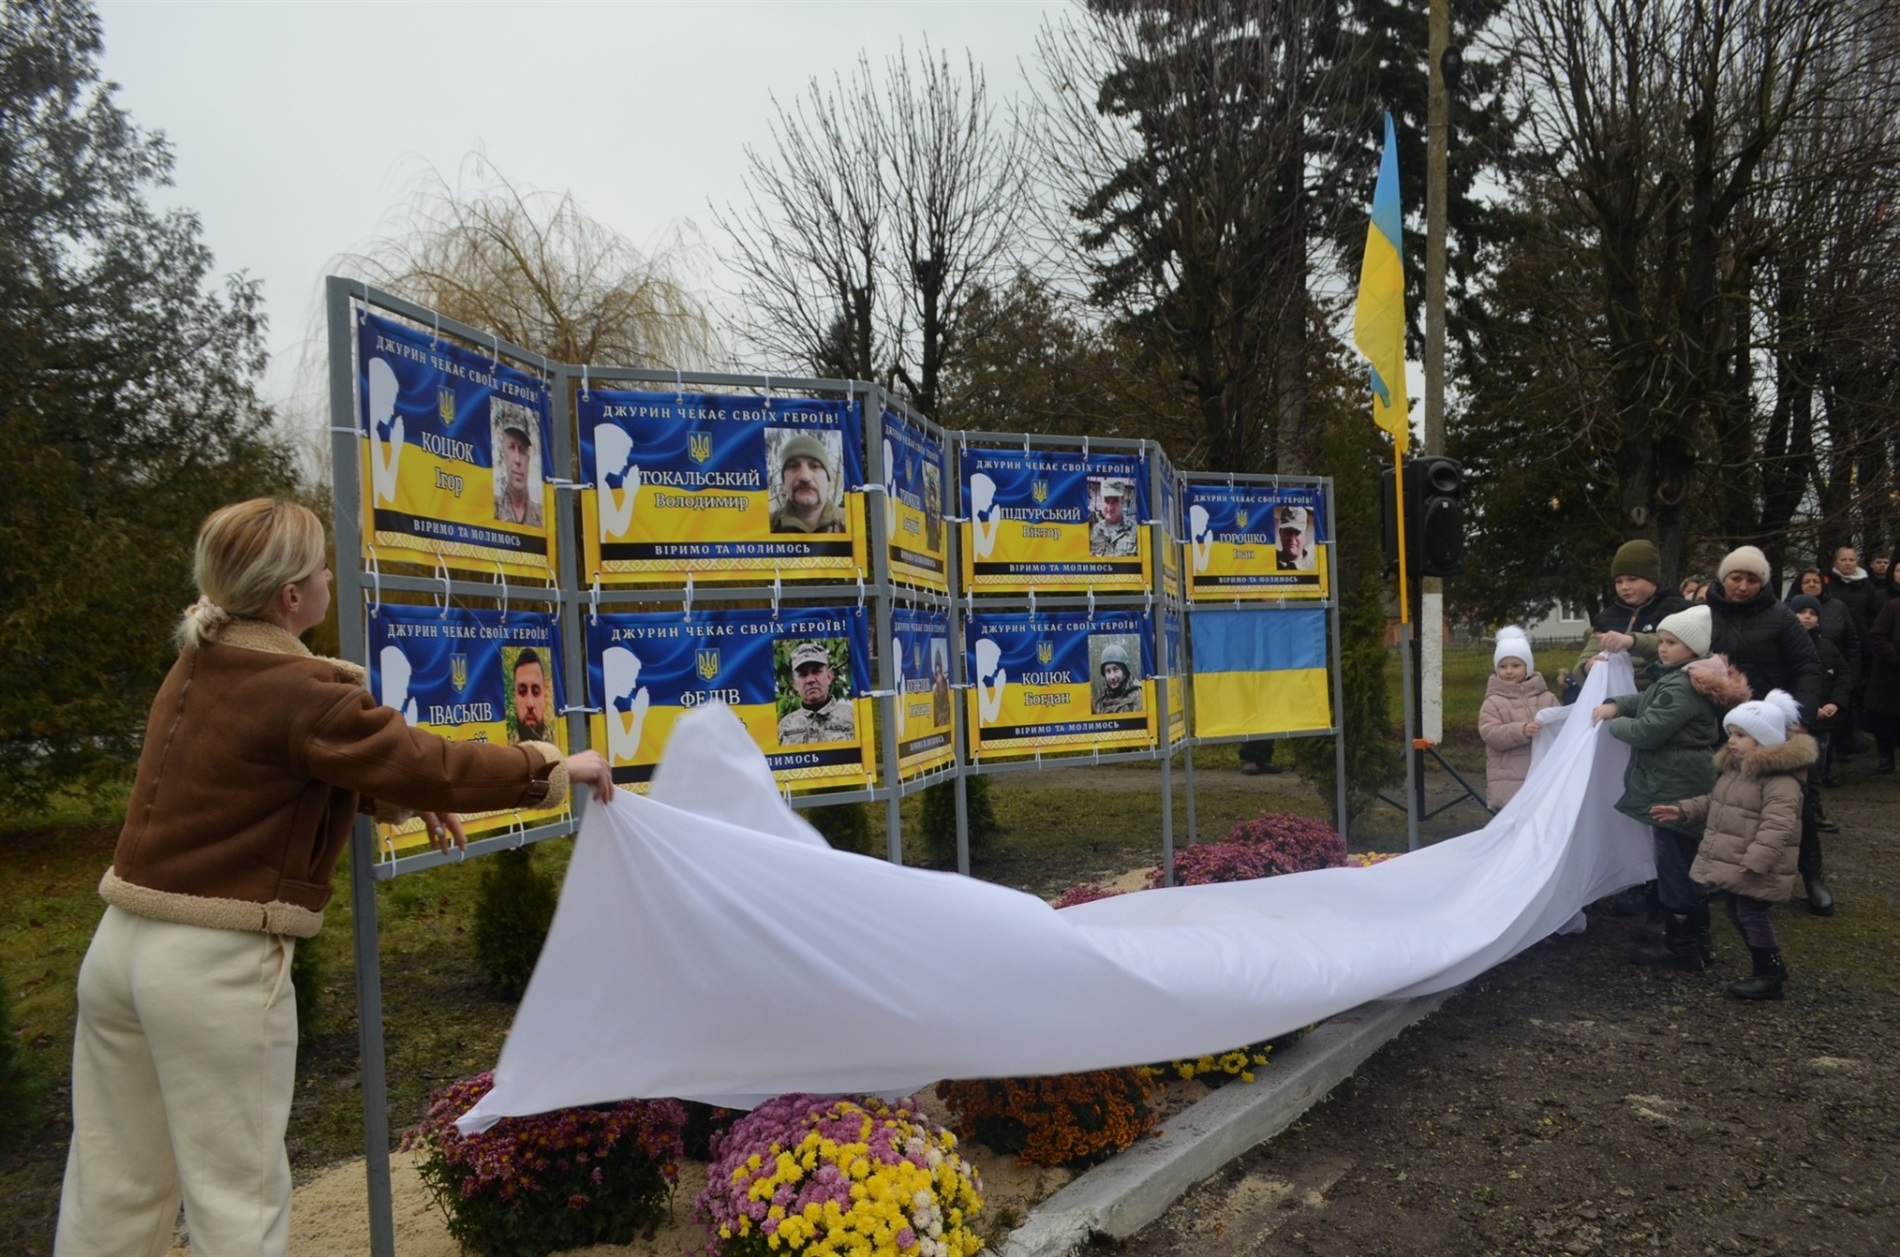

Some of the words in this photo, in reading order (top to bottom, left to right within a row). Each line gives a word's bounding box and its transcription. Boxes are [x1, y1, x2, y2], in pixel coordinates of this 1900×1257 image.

[376, 336, 426, 362] ДЖУРИН
[431, 356, 466, 379] ЧЕКАЄ
[469, 370, 498, 388] СВОЇХ
[502, 384, 538, 403] ГЕРОЇВ!
[602, 406, 670, 418] ДЖУРИН
[677, 408, 726, 420] ЧЕКАЄ
[732, 407, 777, 422] СВОЇХ
[783, 410, 839, 424] ГЕРОЇВ!
[421, 432, 474, 463] КОЦЮК
[976, 461, 1021, 470] ДЖУРИН
[1026, 462, 1059, 471] ЧЕКАЄ
[1062, 462, 1092, 472] СВОЇХ
[1096, 464, 1135, 474] ГЕРОЇВ!
[435, 467, 464, 497] Ігор
[639, 470, 760, 486] ТОКАЛЬСЬКИЙ
[655, 494, 749, 511] Володимир
[414, 519, 454, 536] ВІРИМО
[458, 526, 468, 538] ТА
[472, 528, 521, 546] МОЛИМОСЬ
[1022, 526, 1062, 540] Віктор
[655, 545, 710, 555] ВІРИМО
[715, 544, 730, 554] ТА
[736, 544, 810, 554] МОЛИМОСЬ
[1233, 548, 1255, 560] Іван
[1010, 564, 1046, 572] ВІРИМО
[1050, 564, 1060, 572] ТА
[1064, 564, 1114, 572] МОЛИМОСЬ
[388, 624, 437, 639] ДЖУРИН
[442, 626, 476, 639] ЧЕКАЄ
[480, 625, 510, 639] СВОЇХ
[513, 628, 549, 639] ГЕРОЇВ!
[611, 627, 679, 641] ДЖУРИН
[686, 625, 734, 637] ЧЕКАЄ
[740, 621, 784, 634] СВОЇХ
[791, 620, 847, 633] ГЕРОЇВ!
[982, 624, 1026, 635] ДЖУРИН
[1030, 624, 1063, 632] ЧЕКАЄ
[1066, 621, 1096, 631] СВОЇХ
[1100, 620, 1138, 630] ГЕРОЇВ!
[1022, 670, 1071, 686] КОЦЮК
[1024, 692, 1071, 707] Богдан
[429, 702, 492, 725] ІВАСЬКІВ
[1014, 726, 1052, 736] ВІРИМО
[1055, 724, 1065, 732] ТА
[1068, 722, 1120, 732] МОЛИМОСЬ
[767, 754, 819, 766] ЛИМОСЬ
